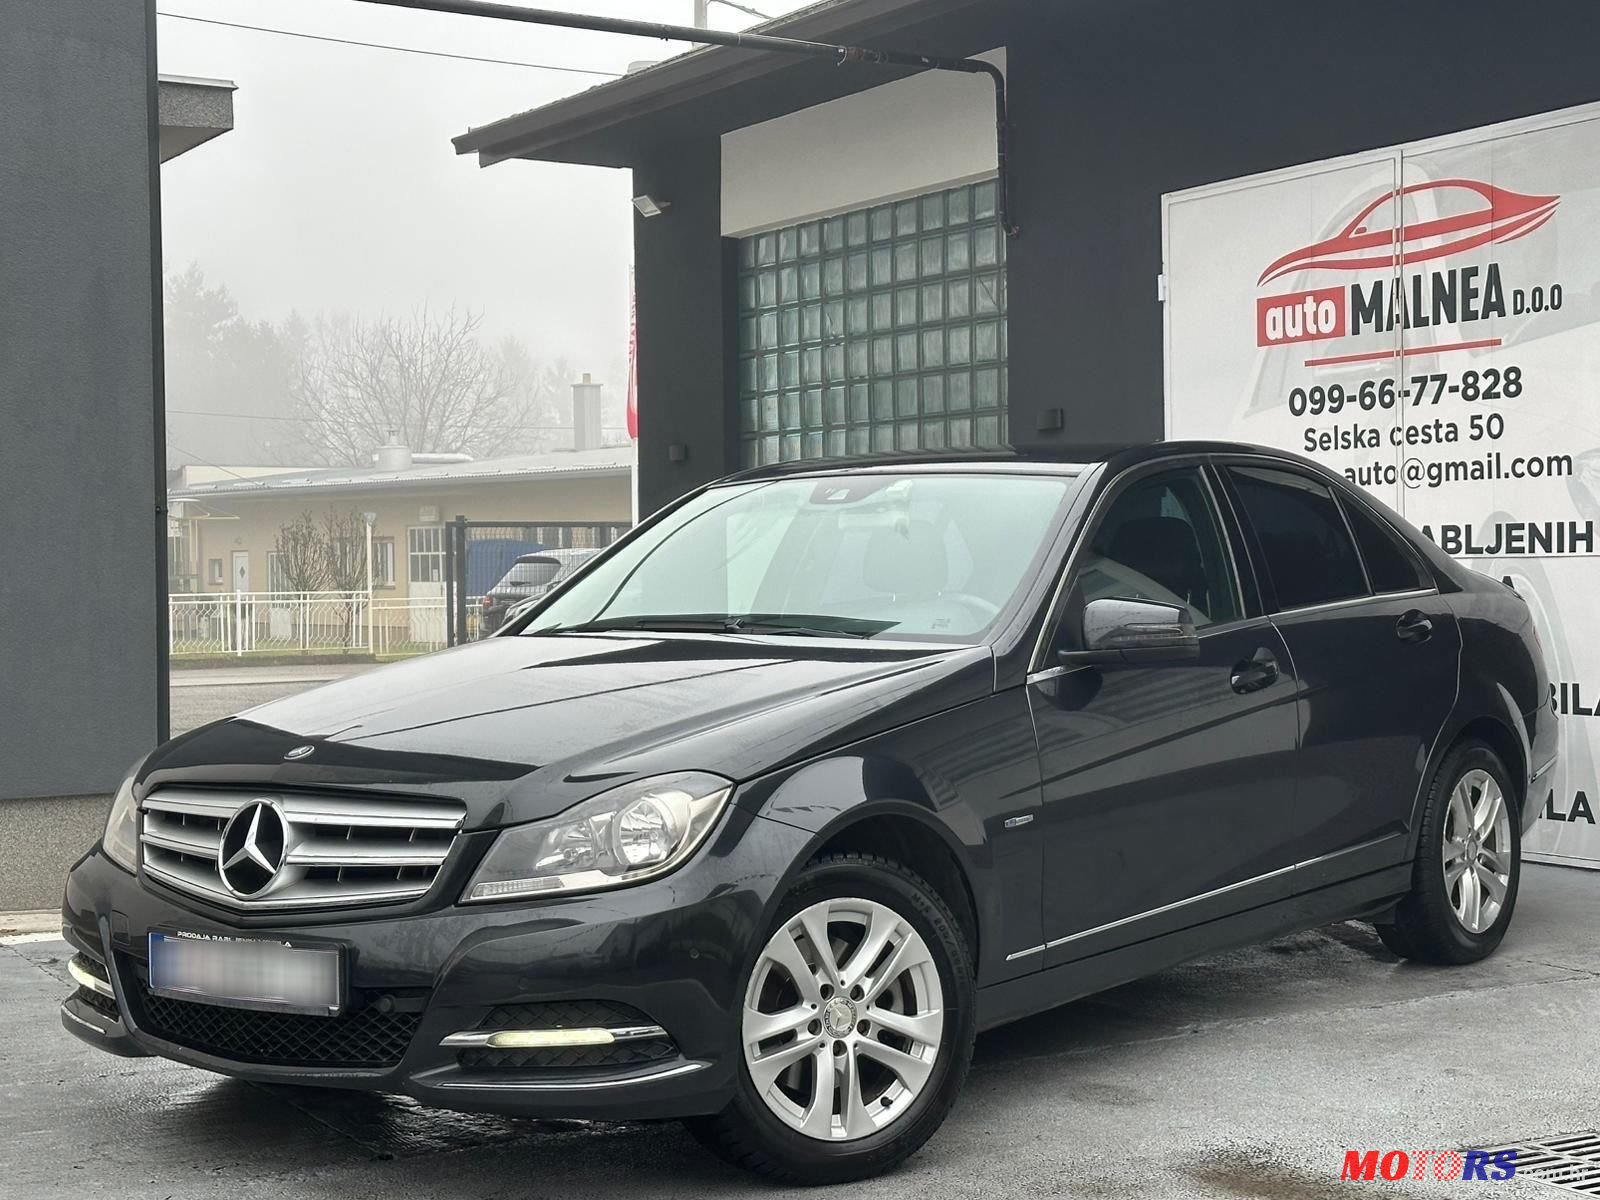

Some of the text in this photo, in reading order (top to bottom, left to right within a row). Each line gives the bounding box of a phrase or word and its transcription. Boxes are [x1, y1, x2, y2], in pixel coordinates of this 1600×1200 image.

[1265, 263, 1563, 341] auto MALNEA D.O.O
[1288, 366, 1523, 417] 099-66-77-828
[1303, 412, 1505, 452] Selska cesta 50
[1344, 452, 1573, 489] auto@gmail.com
[177, 931, 212, 941] PRODAJA
